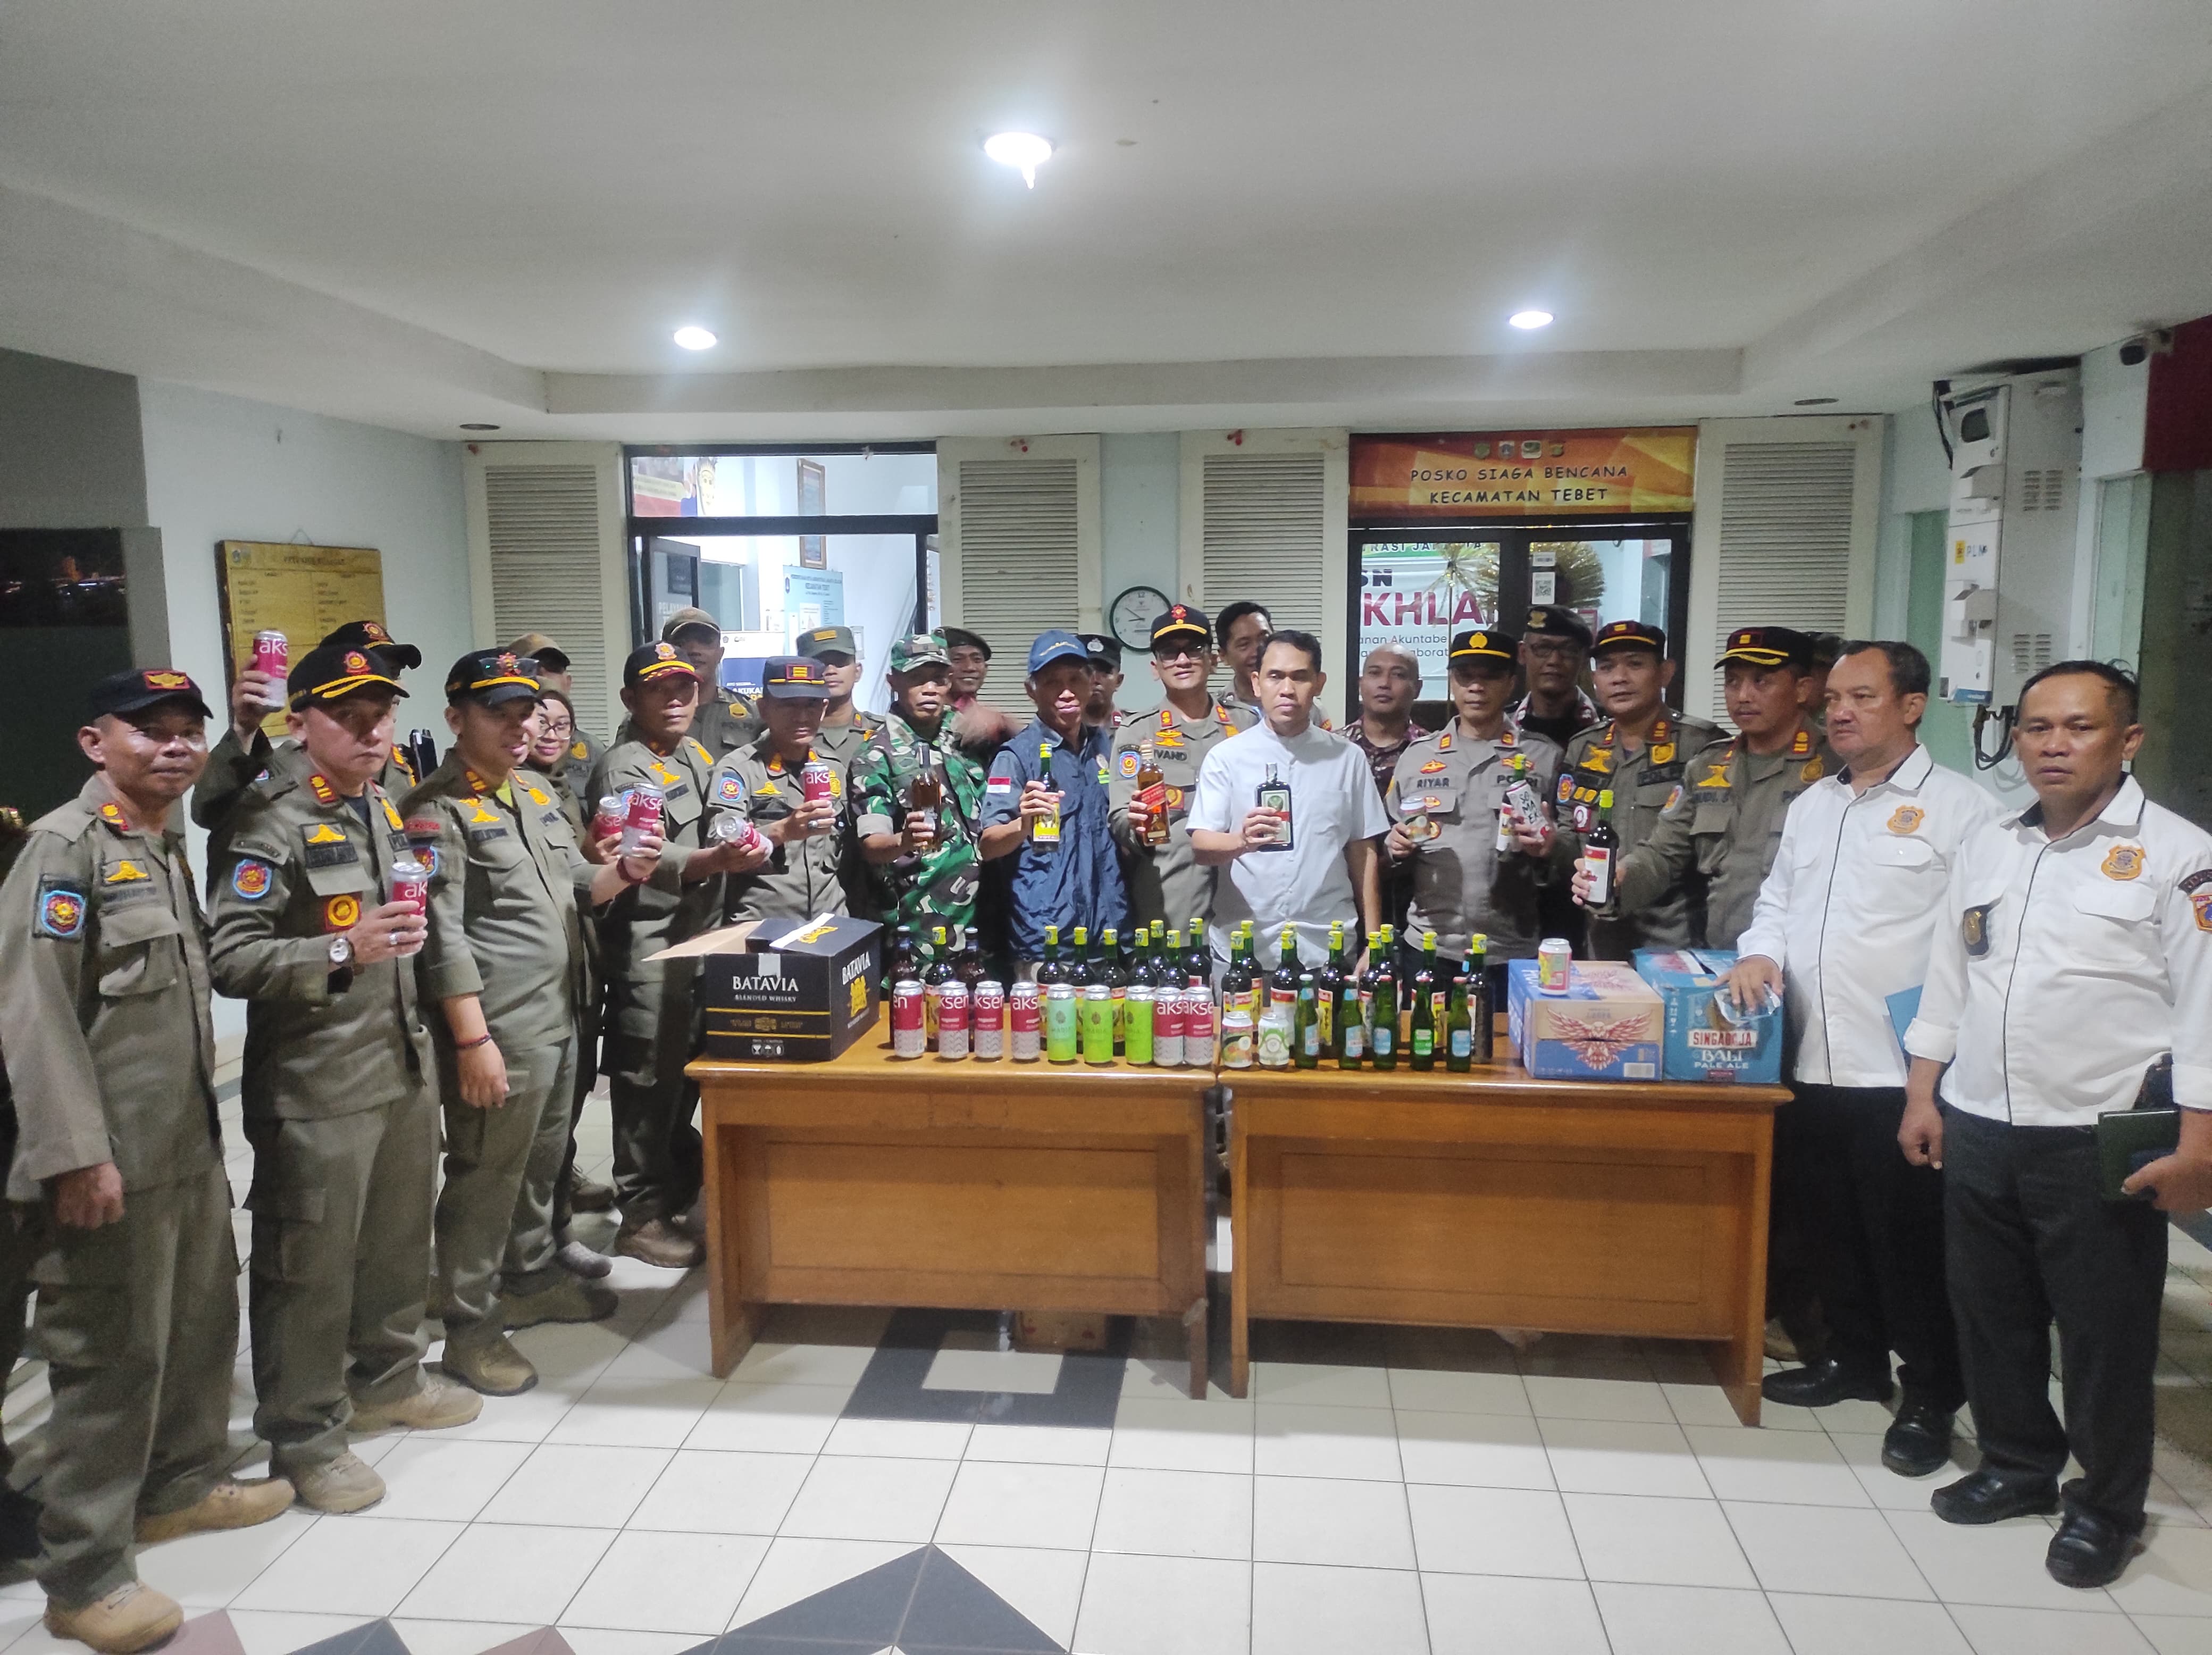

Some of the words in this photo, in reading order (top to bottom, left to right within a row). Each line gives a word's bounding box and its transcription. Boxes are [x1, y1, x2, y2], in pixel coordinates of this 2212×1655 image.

[1411, 469, 1468, 481] POSKO
[1478, 468, 1534, 479] SIAGA
[1544, 466, 1628, 479] BENCANA
[1430, 490, 1540, 504] KECAMATAN
[1552, 488, 1607, 501] TEBET
[1363, 591, 1497, 626] KHLA
[1417, 777, 1450, 788] RIYAR
[1496, 774, 1538, 787] PORI
[842, 951, 871, 985] BATAVIA
[733, 975, 799, 992] BATAVIA
